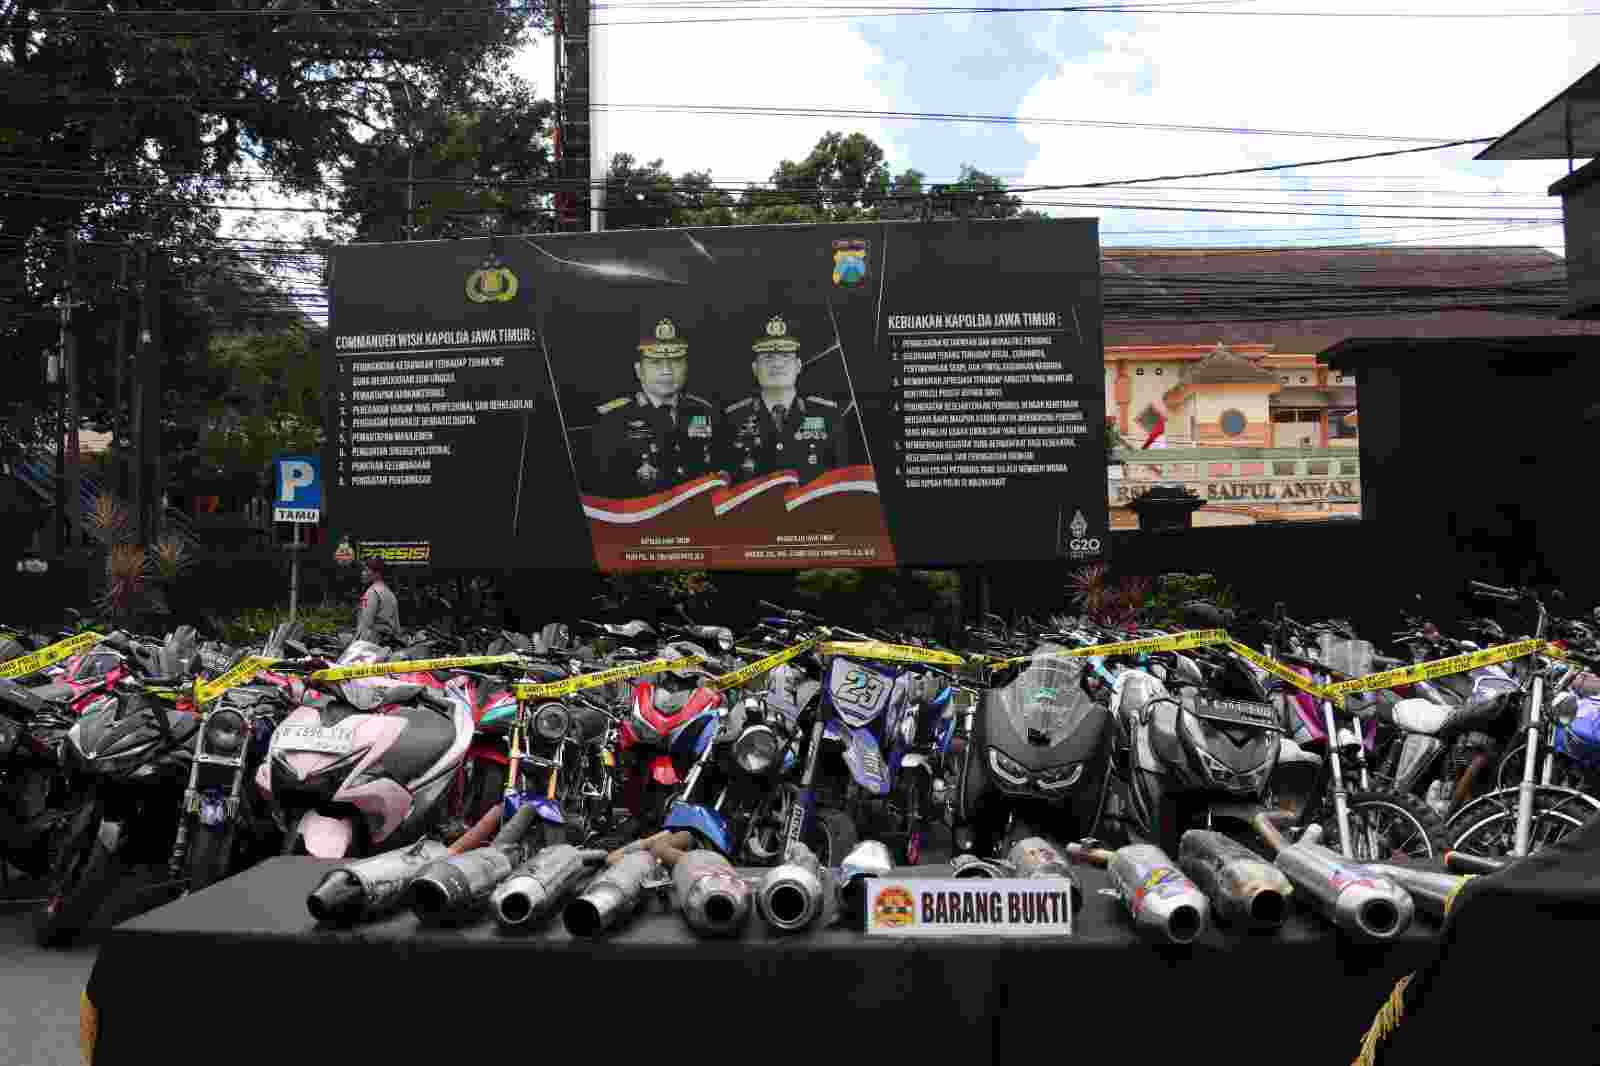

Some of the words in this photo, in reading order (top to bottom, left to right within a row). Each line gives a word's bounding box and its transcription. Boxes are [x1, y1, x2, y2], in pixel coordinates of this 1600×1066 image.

[888, 314, 943, 329] KEBIJAKAN
[945, 313, 992, 329] KAPOLDA
[993, 313, 1020, 327] JAWA
[398, 332, 425, 347] WISH
[425, 330, 469, 346] KAPOLDA
[471, 329, 499, 344] JAWA
[279, 460, 315, 502] P
[1207, 482, 1274, 497] SAIFUL
[1281, 480, 1354, 497] ANWAR
[278, 510, 317, 521] TAMU
[1070, 538, 1101, 551] G20
[921, 891, 1003, 924] BARANG
[1008, 891, 1068, 924] BUKTI
